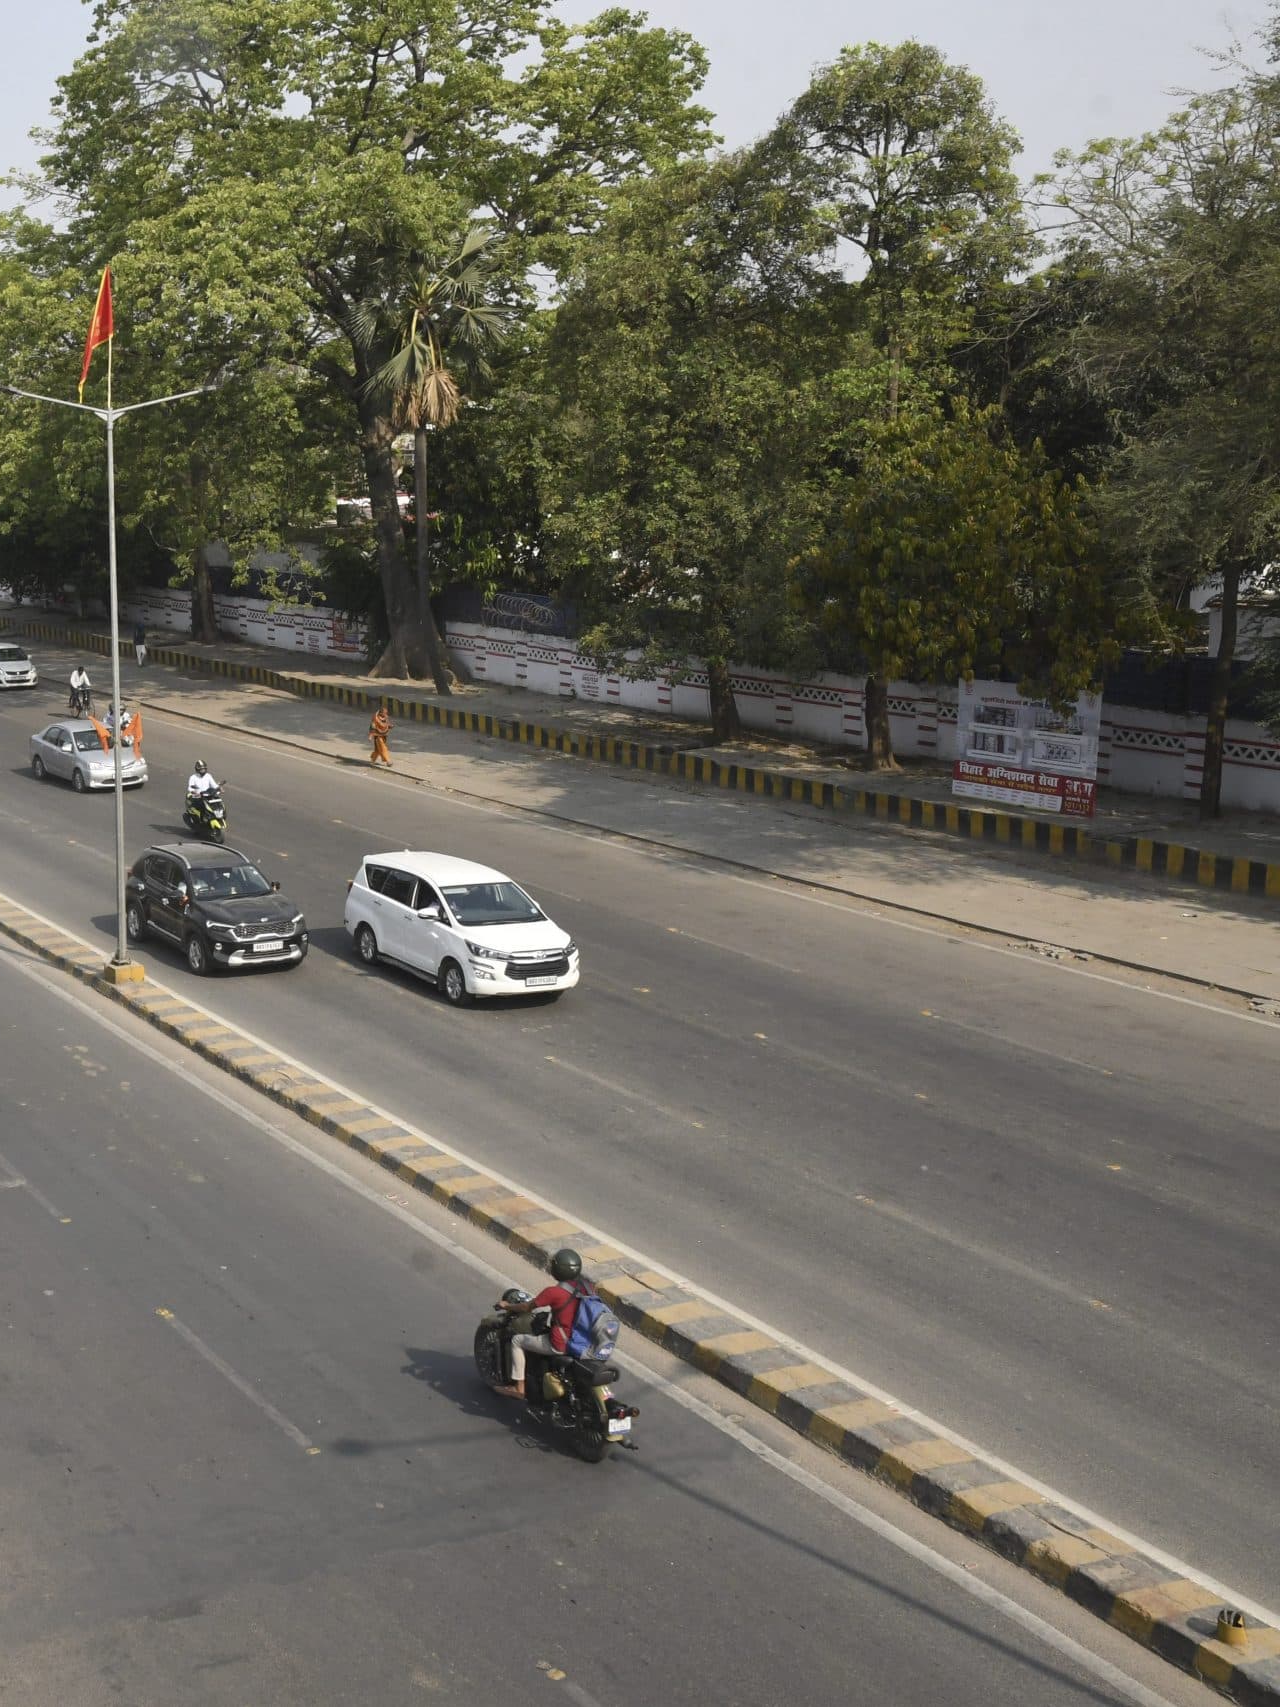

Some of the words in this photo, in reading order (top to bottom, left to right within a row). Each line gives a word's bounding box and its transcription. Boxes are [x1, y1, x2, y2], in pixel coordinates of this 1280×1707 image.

[959, 761, 984, 776] बिहार
[987, 766, 1035, 784] अग्निशमन
[1038, 772, 1059, 788] सेवा
